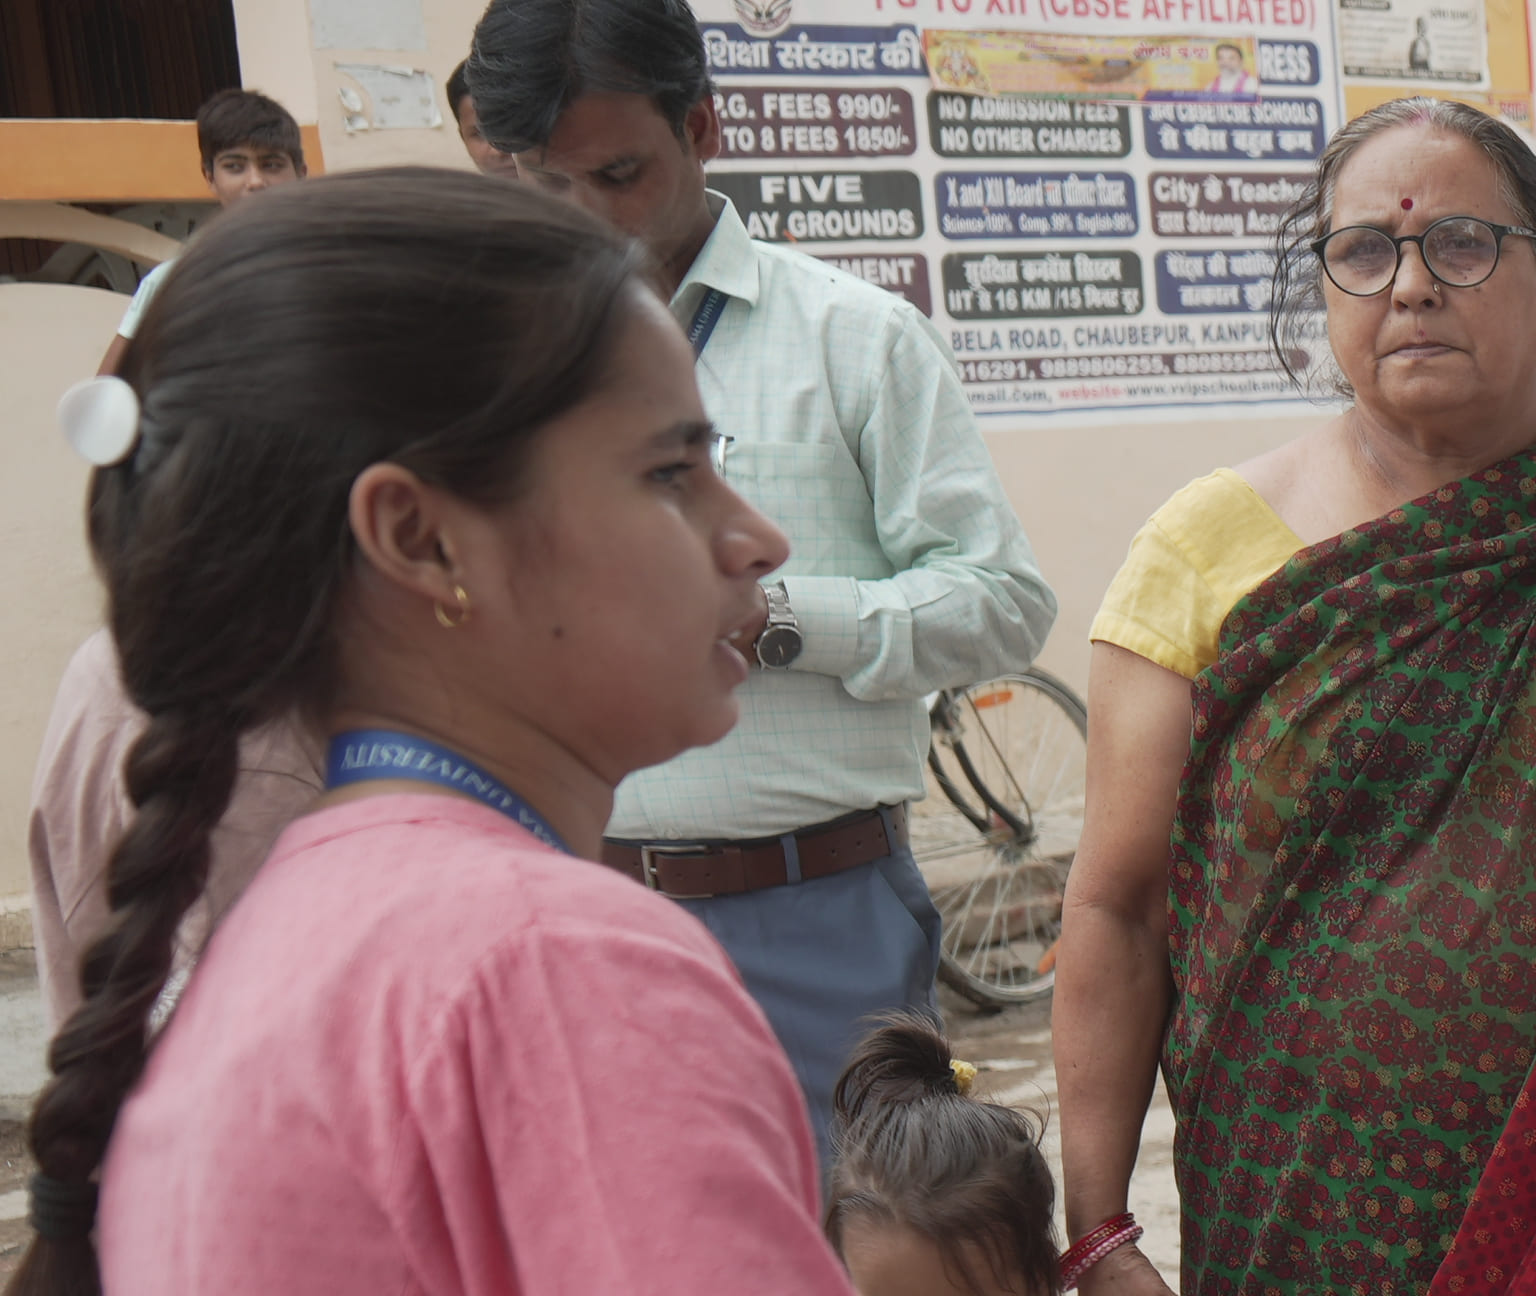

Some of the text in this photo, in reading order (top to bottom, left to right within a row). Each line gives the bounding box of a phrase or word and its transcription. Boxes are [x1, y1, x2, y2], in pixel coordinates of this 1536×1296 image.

[1143, 0, 1316, 30] AFFILIATED)
[706, 29, 921, 70] शिक्षा संस्कार की
[1260, 44, 1311, 81] RESS
[763, 93, 832, 119] FEES
[837, 93, 900, 119] 990/-
[939, 97, 1120, 123] NO ADMISSION FEES
[1253, 103, 1318, 125] SCHOOLS
[723, 126, 911, 151] TO 8 FEES 1850/-
[941, 127, 1122, 153] NO OTHER CHARGES
[760, 175, 865, 204] FIVE
[1154, 176, 1200, 208] City
[1227, 177, 1312, 202] Teach
[747, 208, 916, 238] AY GROUNDS
[1186, 209, 1245, 237] Strong
[995, 288, 1018, 311] 16
[1021, 287, 1050, 310] KM
[952, 330, 1001, 350] BELA
[1009, 329, 1068, 351] ROAD,
[1074, 324, 1195, 348] CHAUBEPUR,
